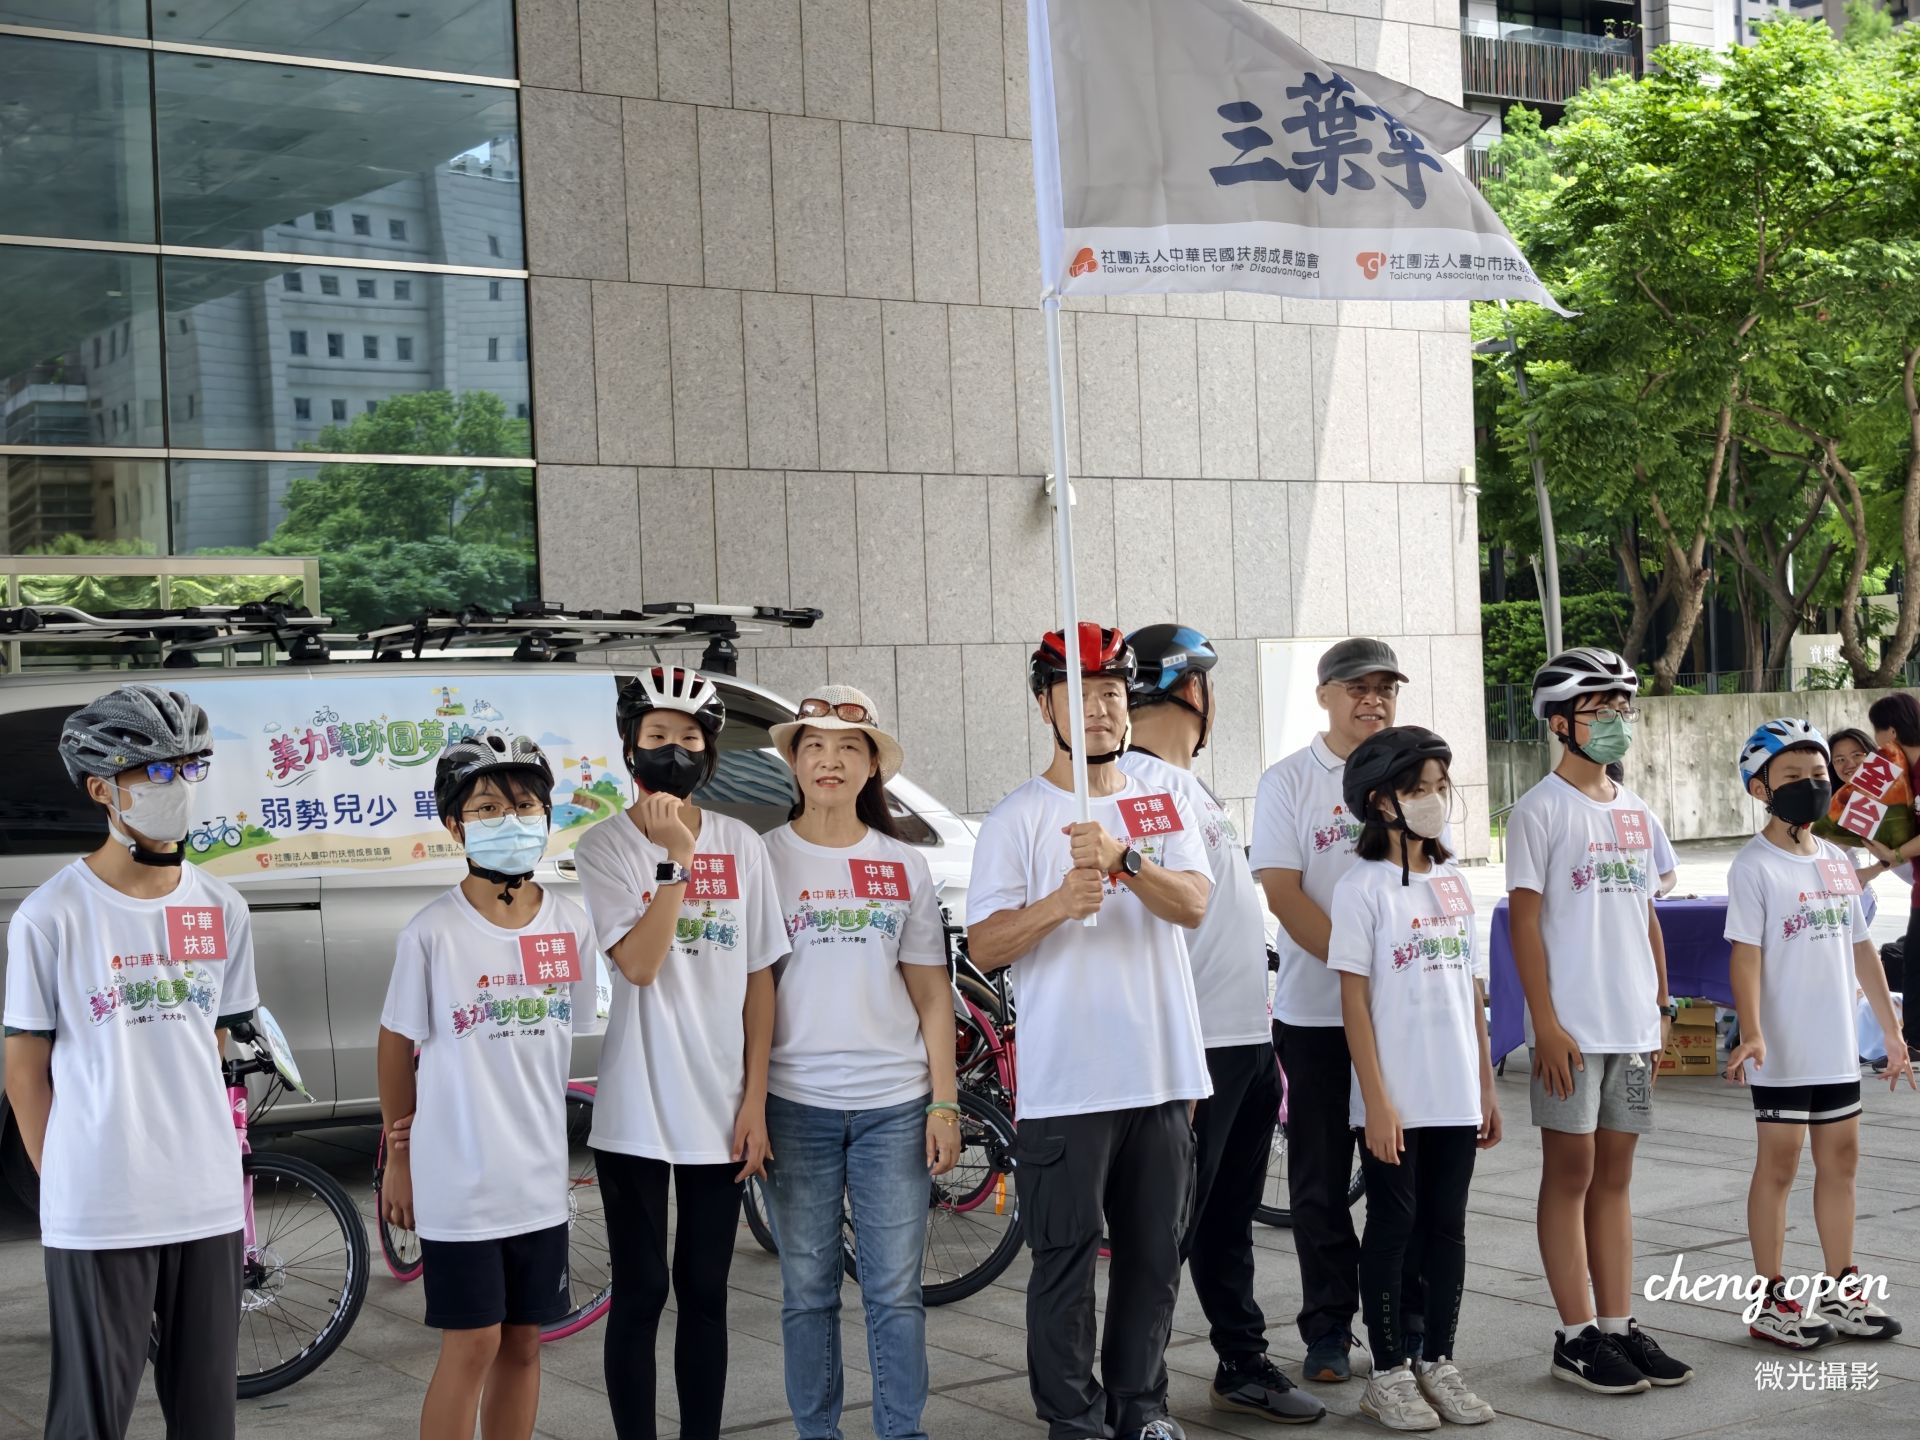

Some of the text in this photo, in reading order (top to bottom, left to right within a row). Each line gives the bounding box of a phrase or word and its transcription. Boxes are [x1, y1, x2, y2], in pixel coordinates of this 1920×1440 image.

[1101, 246, 1319, 269] 社團法人中華民國扶弱成長協會
[1102, 262, 1320, 280] Taiwan Association for the Disadvantaged
[1389, 271, 1432, 281] Taichung
[1436, 270, 1490, 282] Association
[1493, 272, 1505, 280] for
[1508, 273, 1523, 282] the
[261, 793, 397, 831] 弱勢兒少
[1134, 798, 1165, 815] 中華
[1139, 815, 1171, 833] 扶弱
[694, 858, 725, 874] 中華
[864, 863, 895, 879] 中華
[695, 878, 728, 895] 扶弱
[812, 889, 855, 900] 中華扶
[867, 880, 899, 897] 扶弱
[182, 911, 213, 931] 中華
[183, 935, 216, 955] 扶弱
[535, 938, 567, 957] 中華
[538, 960, 570, 980] 扶弱
